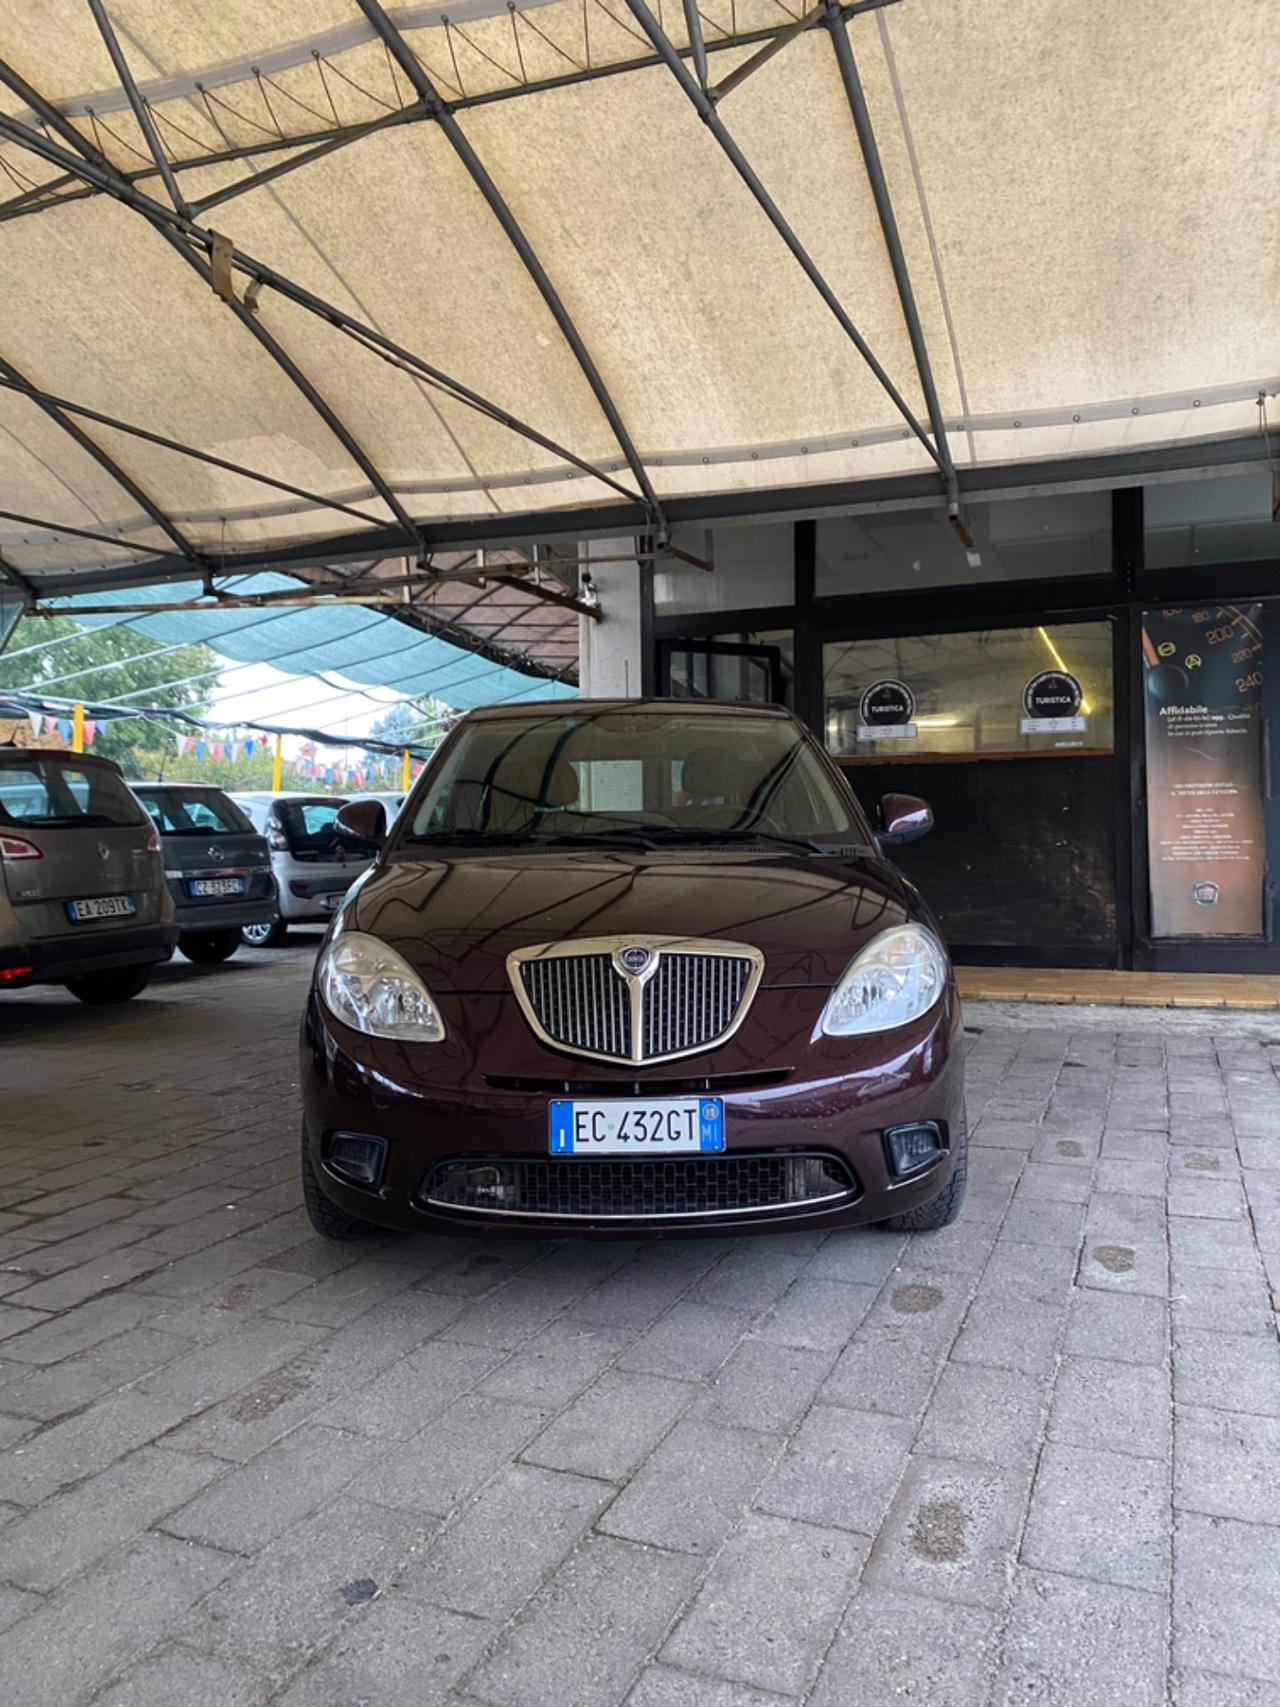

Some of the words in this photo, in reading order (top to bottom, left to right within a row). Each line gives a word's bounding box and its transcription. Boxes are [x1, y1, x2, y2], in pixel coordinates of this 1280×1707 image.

[1206, 625, 1233, 644] 200
[1236, 672, 1263, 692] 240
[1035, 696, 1072, 704] TURISTICA
[871, 705, 904, 714] TURISTICA
[1159, 705, 1208, 716] Affidabile
[77, 901, 93, 918] EA
[575, 1111, 606, 1143] EC
[616, 1109, 697, 1143] 432GT
[702, 1123, 718, 1142] MI
